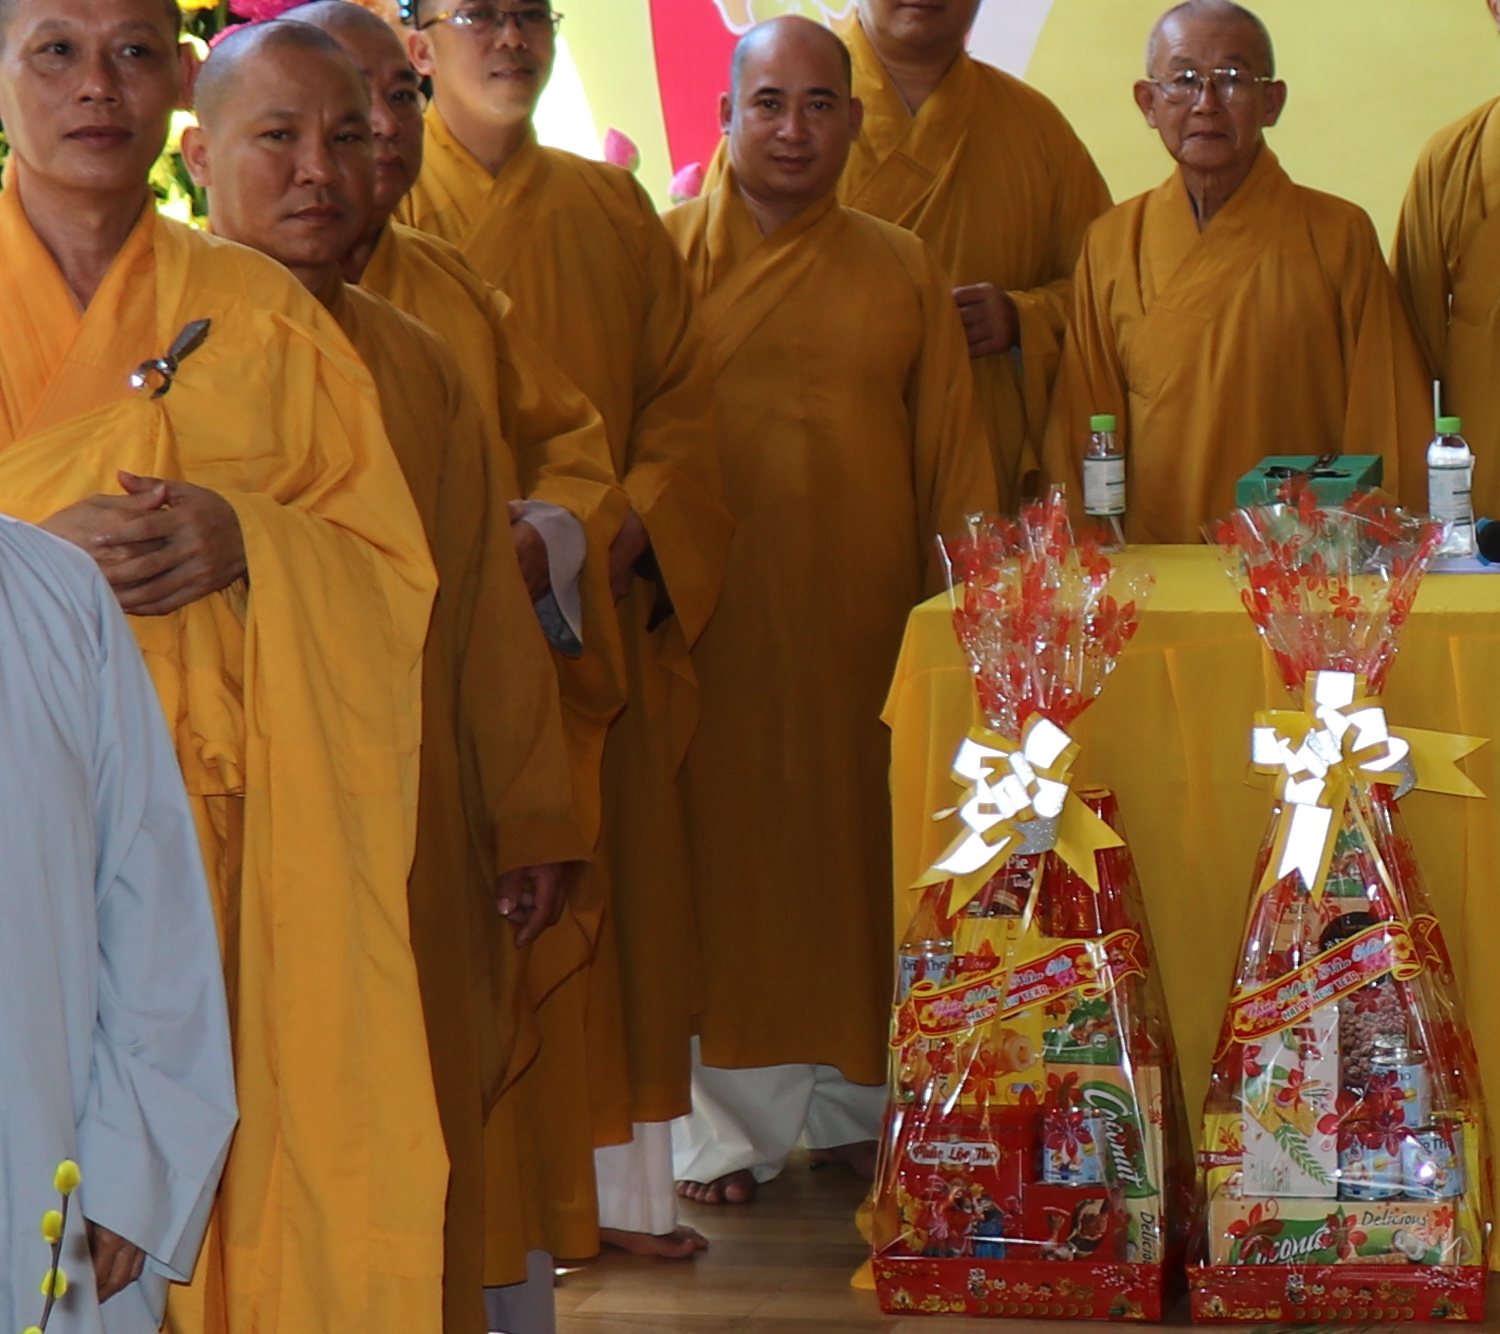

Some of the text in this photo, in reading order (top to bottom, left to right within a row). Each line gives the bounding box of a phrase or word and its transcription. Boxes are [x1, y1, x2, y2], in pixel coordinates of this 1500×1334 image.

[1003, 994, 1020, 1010] EW
[1021, 984, 1050, 1002] YEAR
[1282, 971, 1361, 1021] HAPPY NEW YEAR
[1361, 1209, 1429, 1227] Delicious
